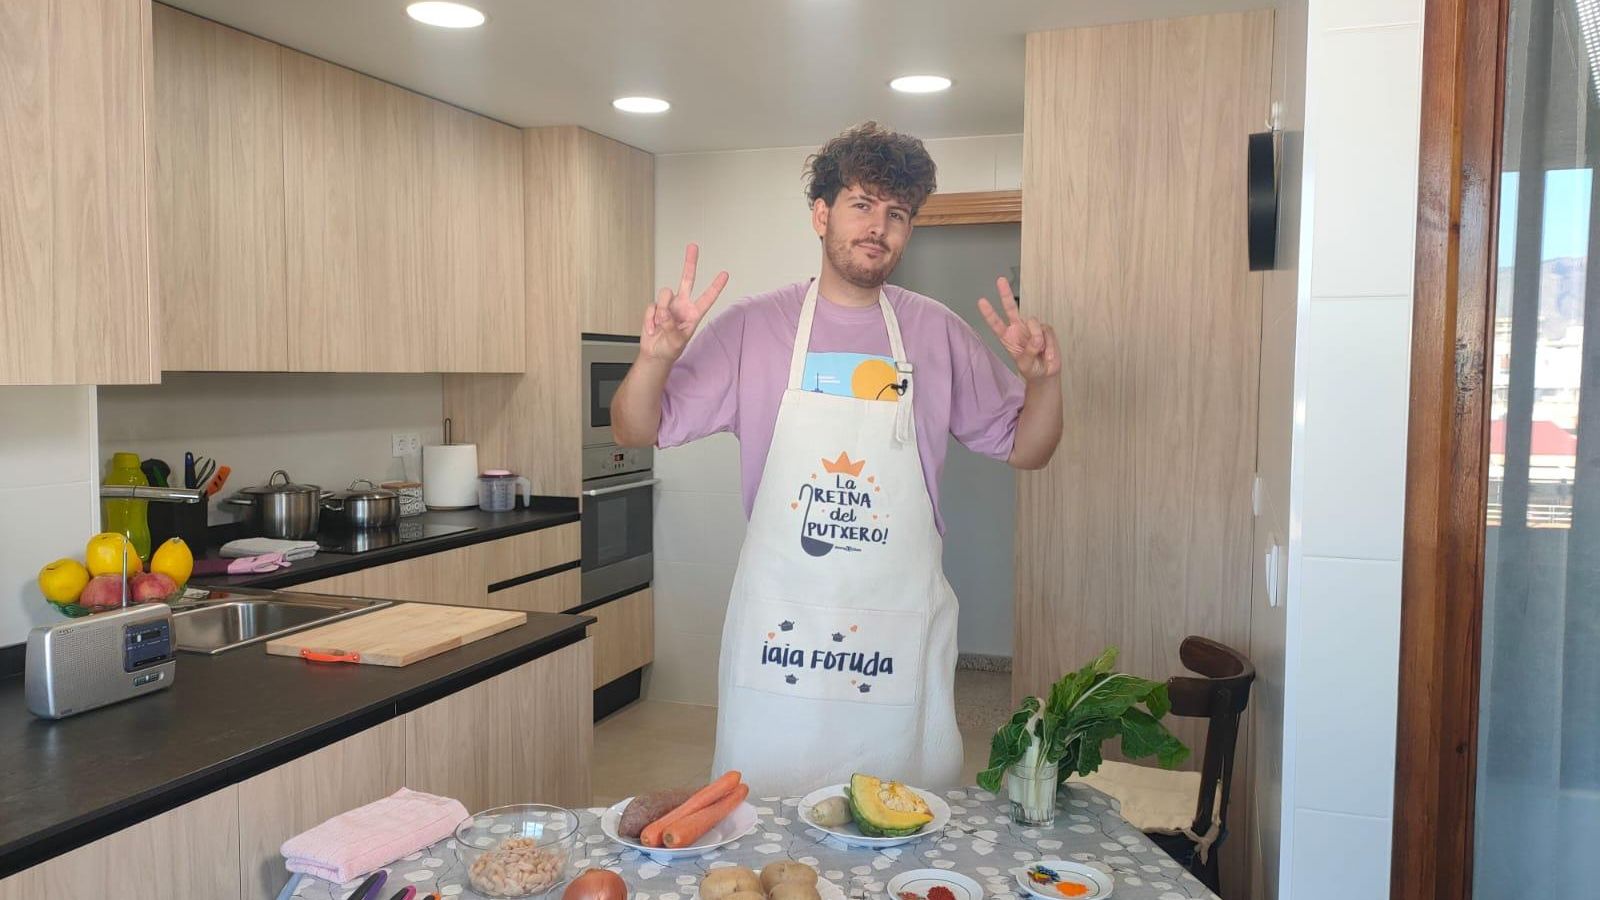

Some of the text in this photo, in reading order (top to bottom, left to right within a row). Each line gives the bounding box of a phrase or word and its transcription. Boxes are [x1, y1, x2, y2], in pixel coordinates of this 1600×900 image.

[836, 474, 857, 490] La
[814, 487, 872, 509] REINA
[829, 507, 857, 523] del
[807, 522, 889, 545] PUTXERO!
[761, 640, 804, 667] iaia
